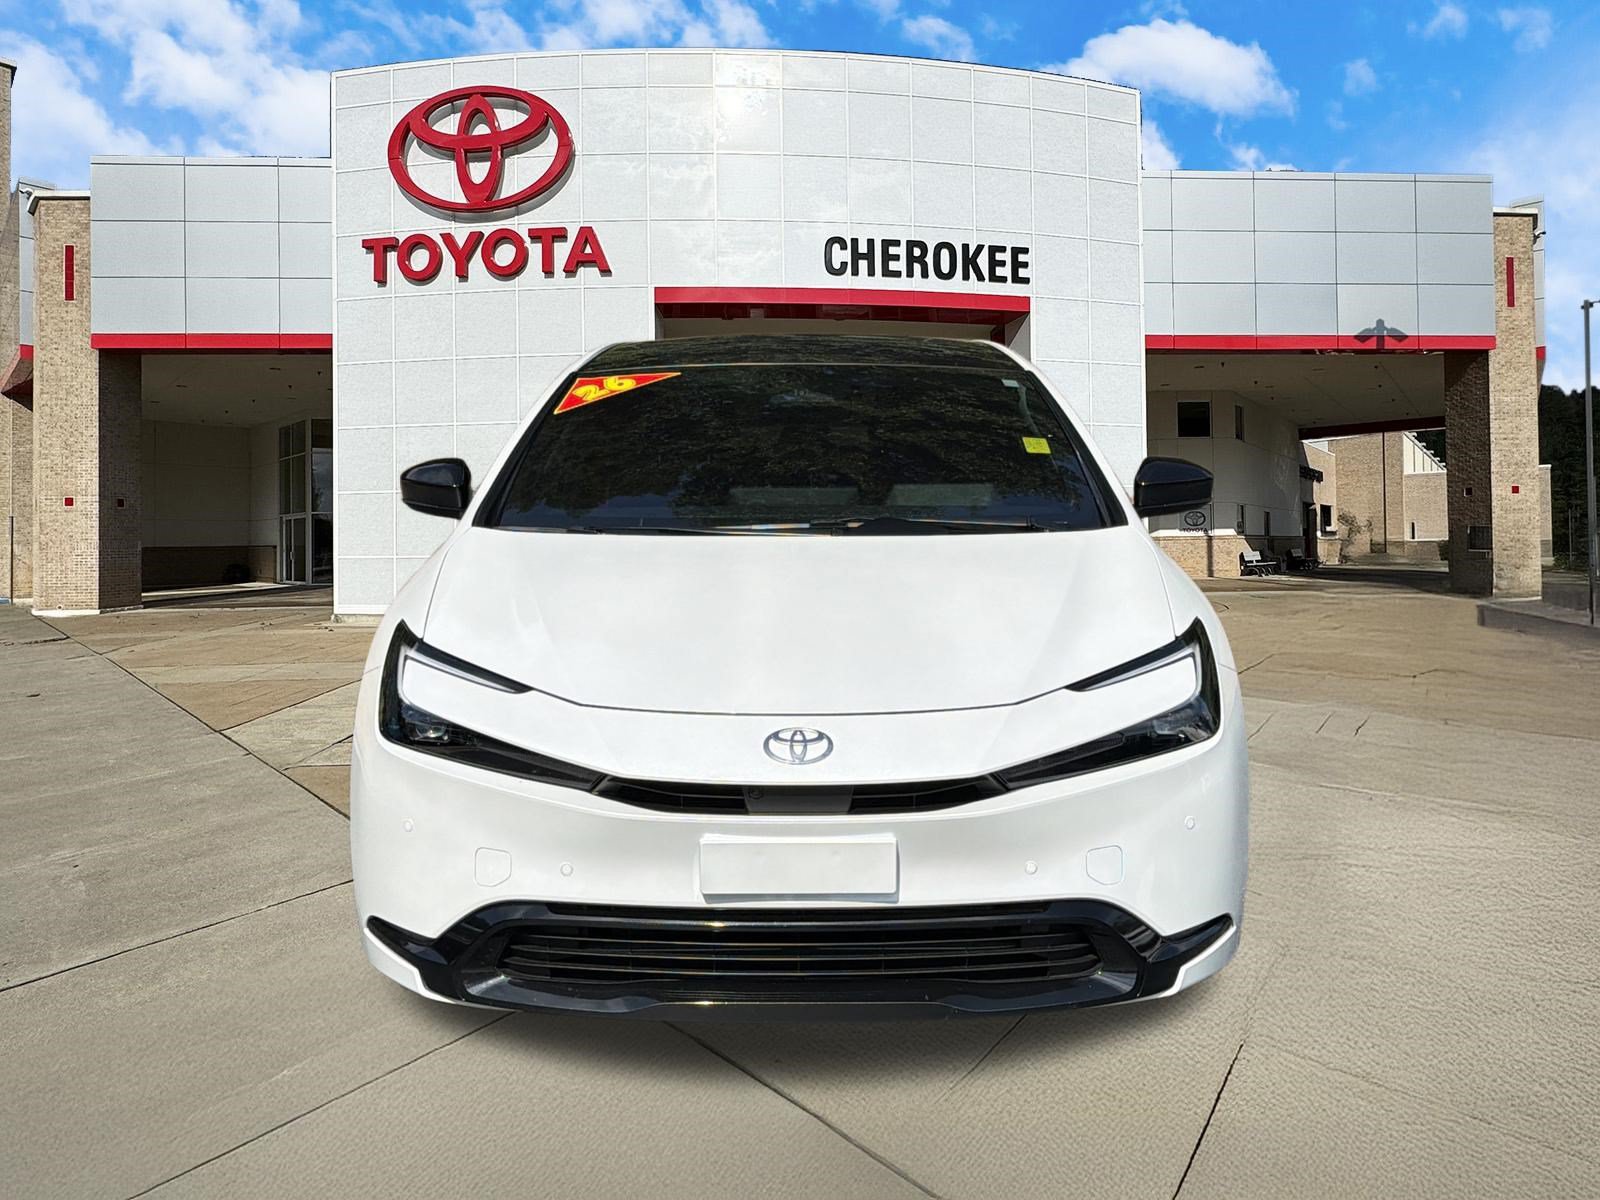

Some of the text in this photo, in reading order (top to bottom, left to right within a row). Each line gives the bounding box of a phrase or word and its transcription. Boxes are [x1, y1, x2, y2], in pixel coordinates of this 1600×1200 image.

[362, 226, 612, 286] TOYOTA
[824, 236, 1031, 284] CHEROKEE
[572, 376, 636, 401] 26
